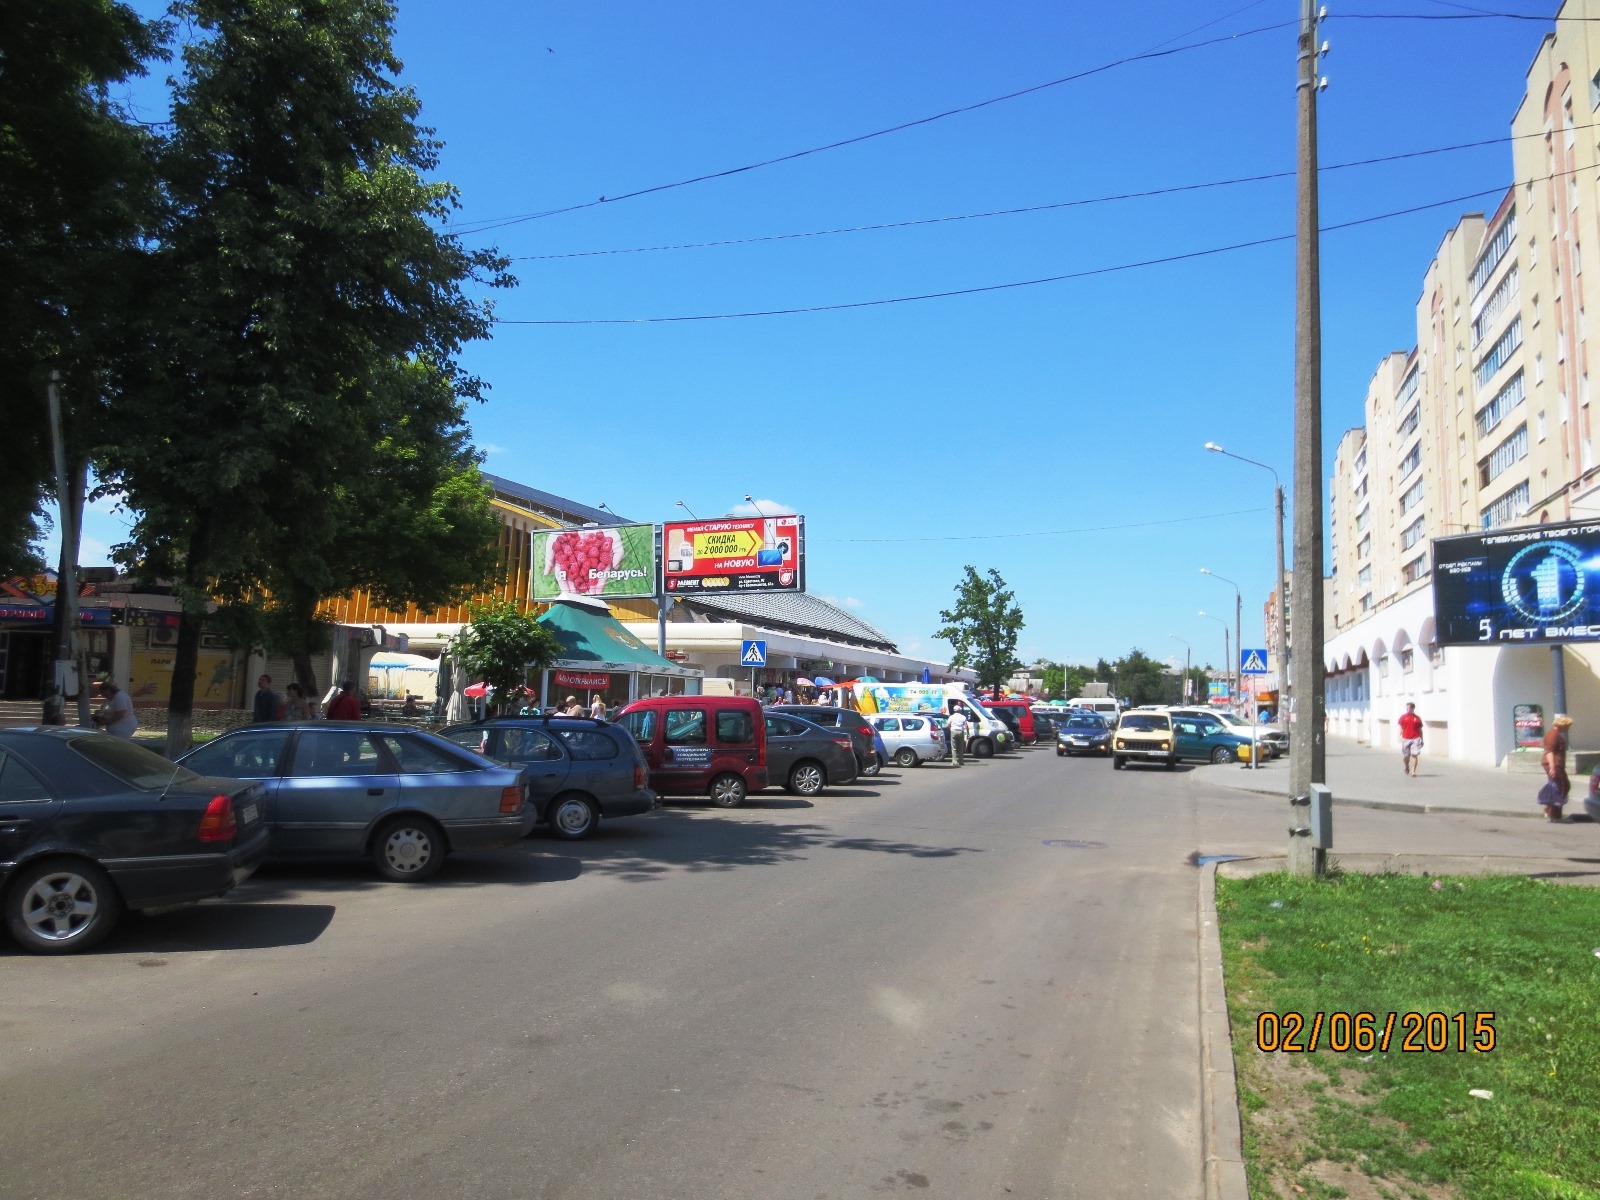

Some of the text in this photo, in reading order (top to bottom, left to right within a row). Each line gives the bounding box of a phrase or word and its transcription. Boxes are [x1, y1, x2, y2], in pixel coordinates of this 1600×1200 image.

[704, 523, 732, 531] СТАРУЮ
[707, 534, 736, 545] СКИДКА
[1481, 531, 1541, 545] ТЕЛЕВИДЕНИЕ
[1543, 528, 1579, 538] ТВОЕГО
[723, 559, 755, 569] НОВУЮ
[559, 566, 647, 581] Я Беларусь!
[1478, 618, 1492, 640] 5
[1499, 628, 1538, 639] ЛЕТ
